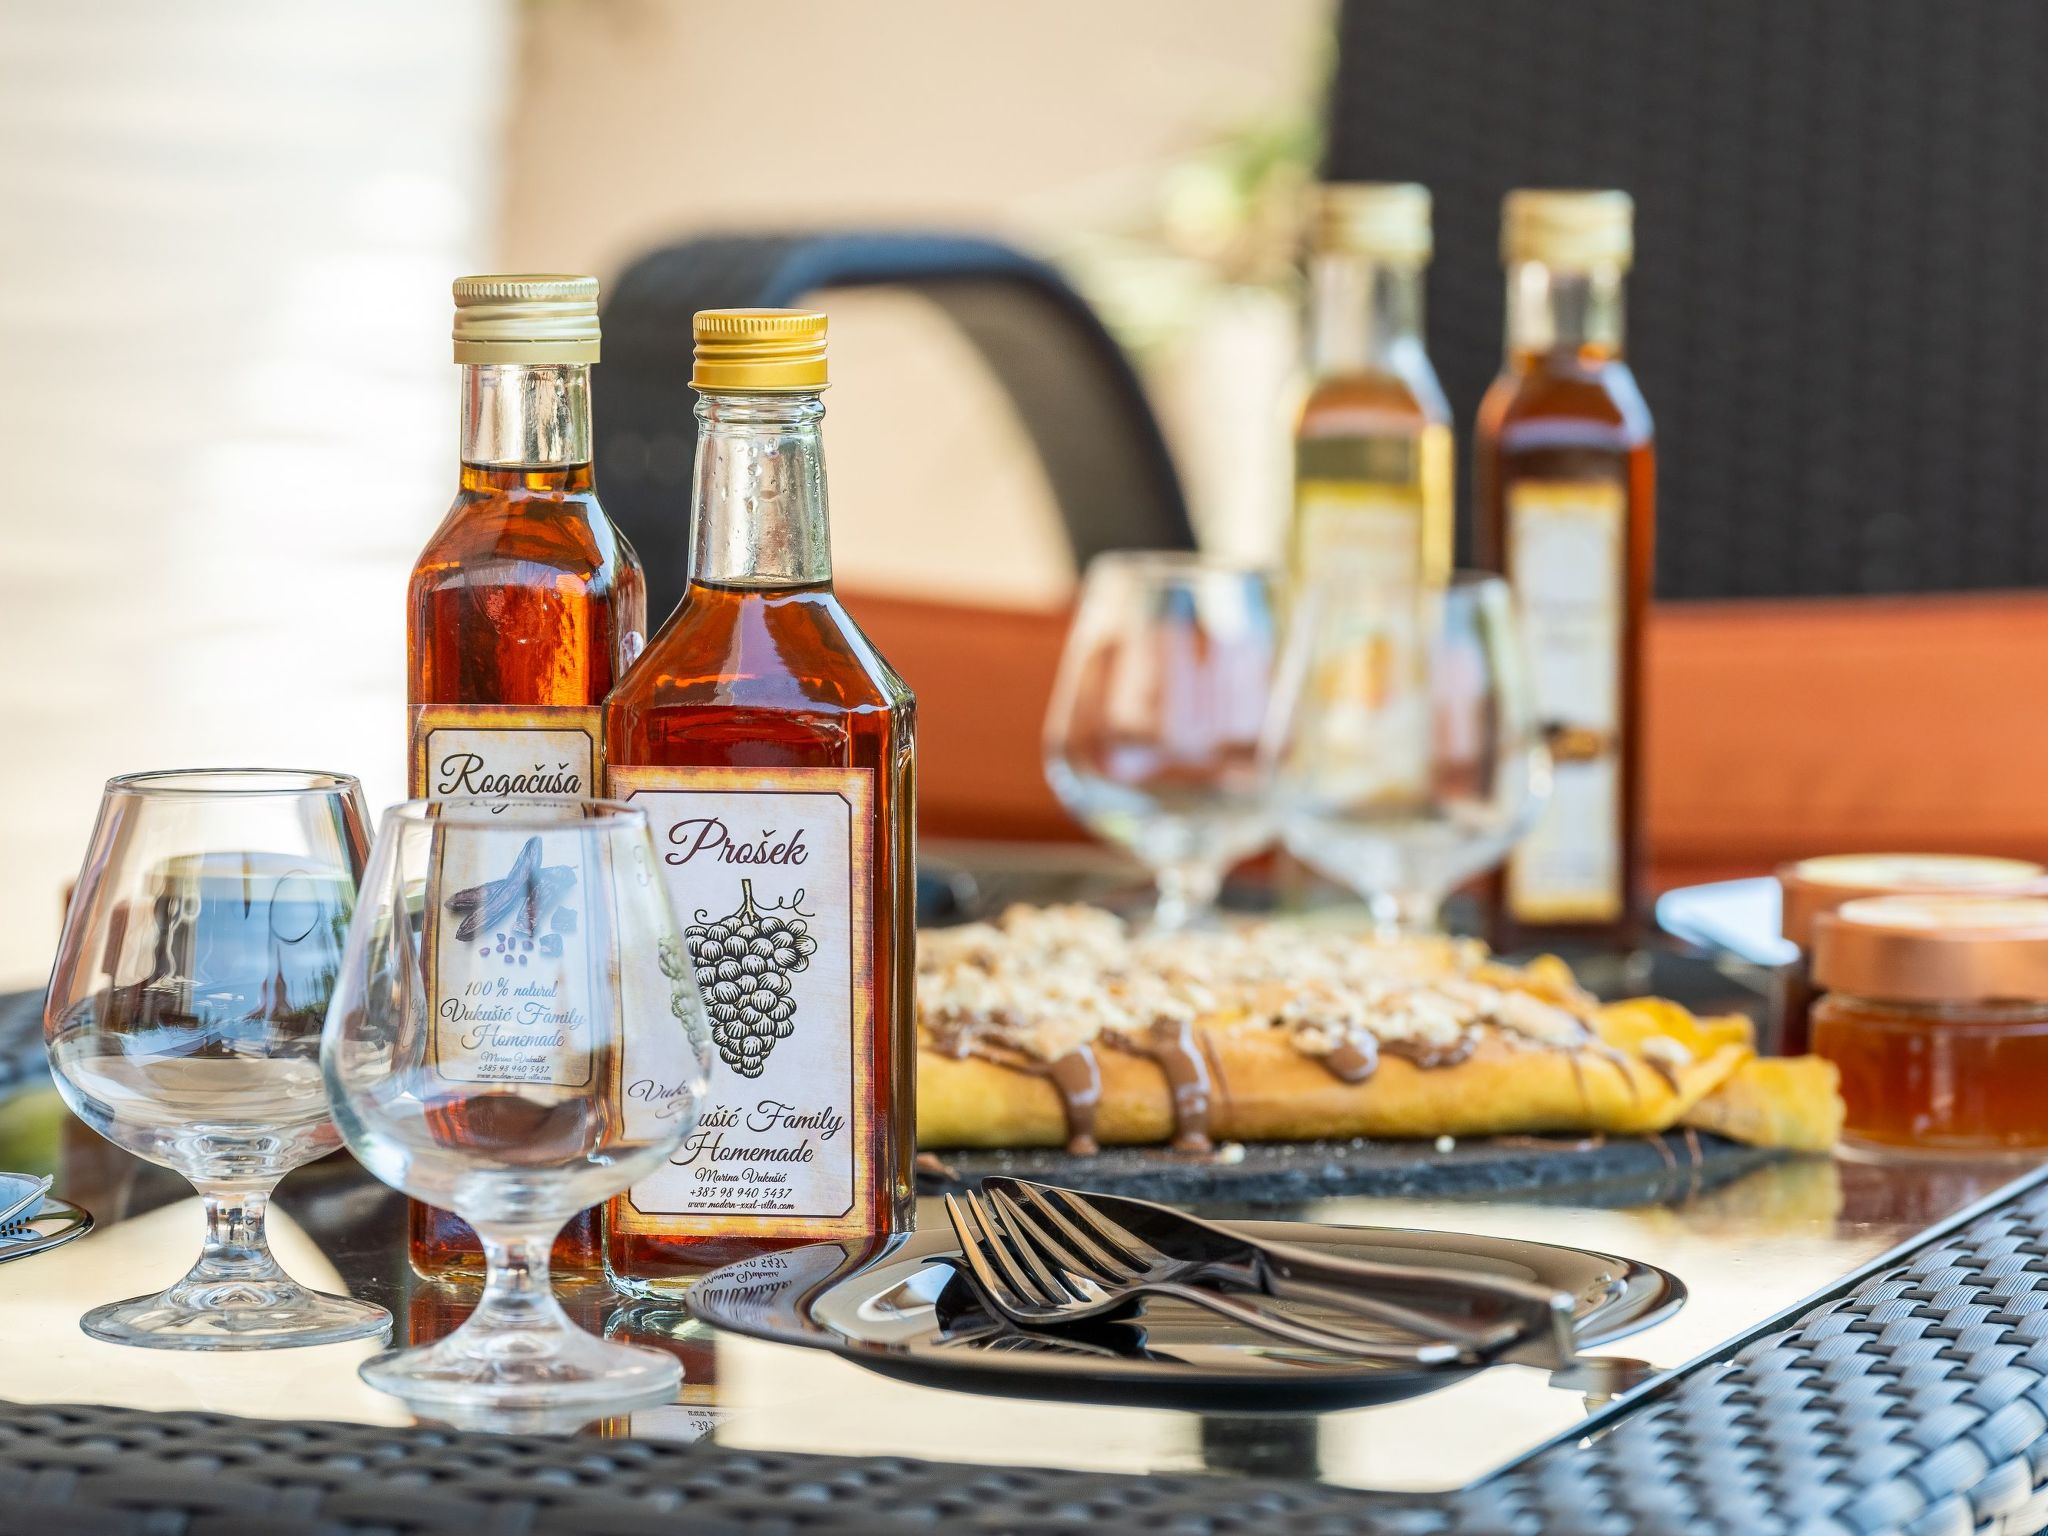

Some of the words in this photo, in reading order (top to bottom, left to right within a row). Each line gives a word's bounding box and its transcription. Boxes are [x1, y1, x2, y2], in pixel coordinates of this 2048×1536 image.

[438, 753, 582, 814] Rogačuša
[664, 817, 809, 866] Prošek
[464, 981, 493, 997] 100
[513, 980, 559, 998] natural
[440, 998, 515, 1023] Vukušić
[516, 1001, 585, 1031] Family
[461, 1023, 566, 1050] Homemade
[499, 1064, 510, 1073] 98
[746, 1100, 845, 1141] Family
[669, 1131, 814, 1166] Homemade
[694, 1167, 740, 1183] Marina
[741, 1167, 788, 1184] Vukušić
[690, 1187, 716, 1198] +385
[720, 1187, 734, 1199] 98
[737, 1187, 759, 1199] 940
[763, 1188, 793, 1199] 5437
